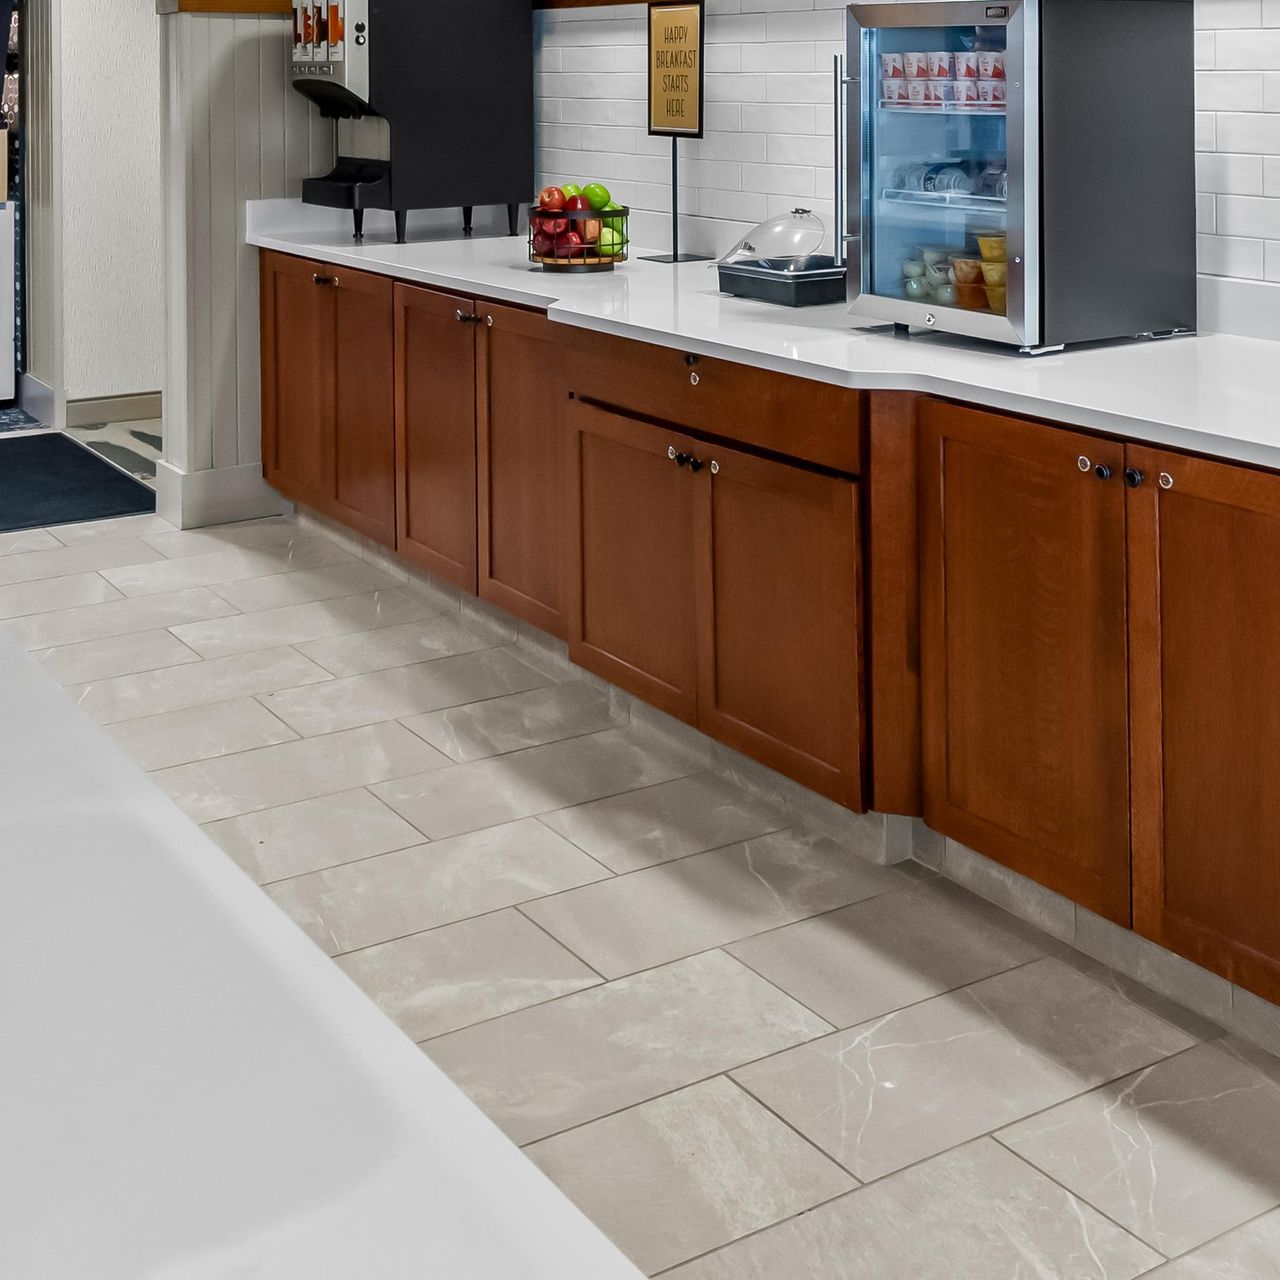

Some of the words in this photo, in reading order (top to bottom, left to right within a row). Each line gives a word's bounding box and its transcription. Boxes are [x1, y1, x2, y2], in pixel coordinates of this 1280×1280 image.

[664, 26, 688, 44] HAPPY
[656, 50, 697, 69] BREAKFAST
[663, 74, 689, 93] STARTS
[665, 98, 686, 118] HERE
